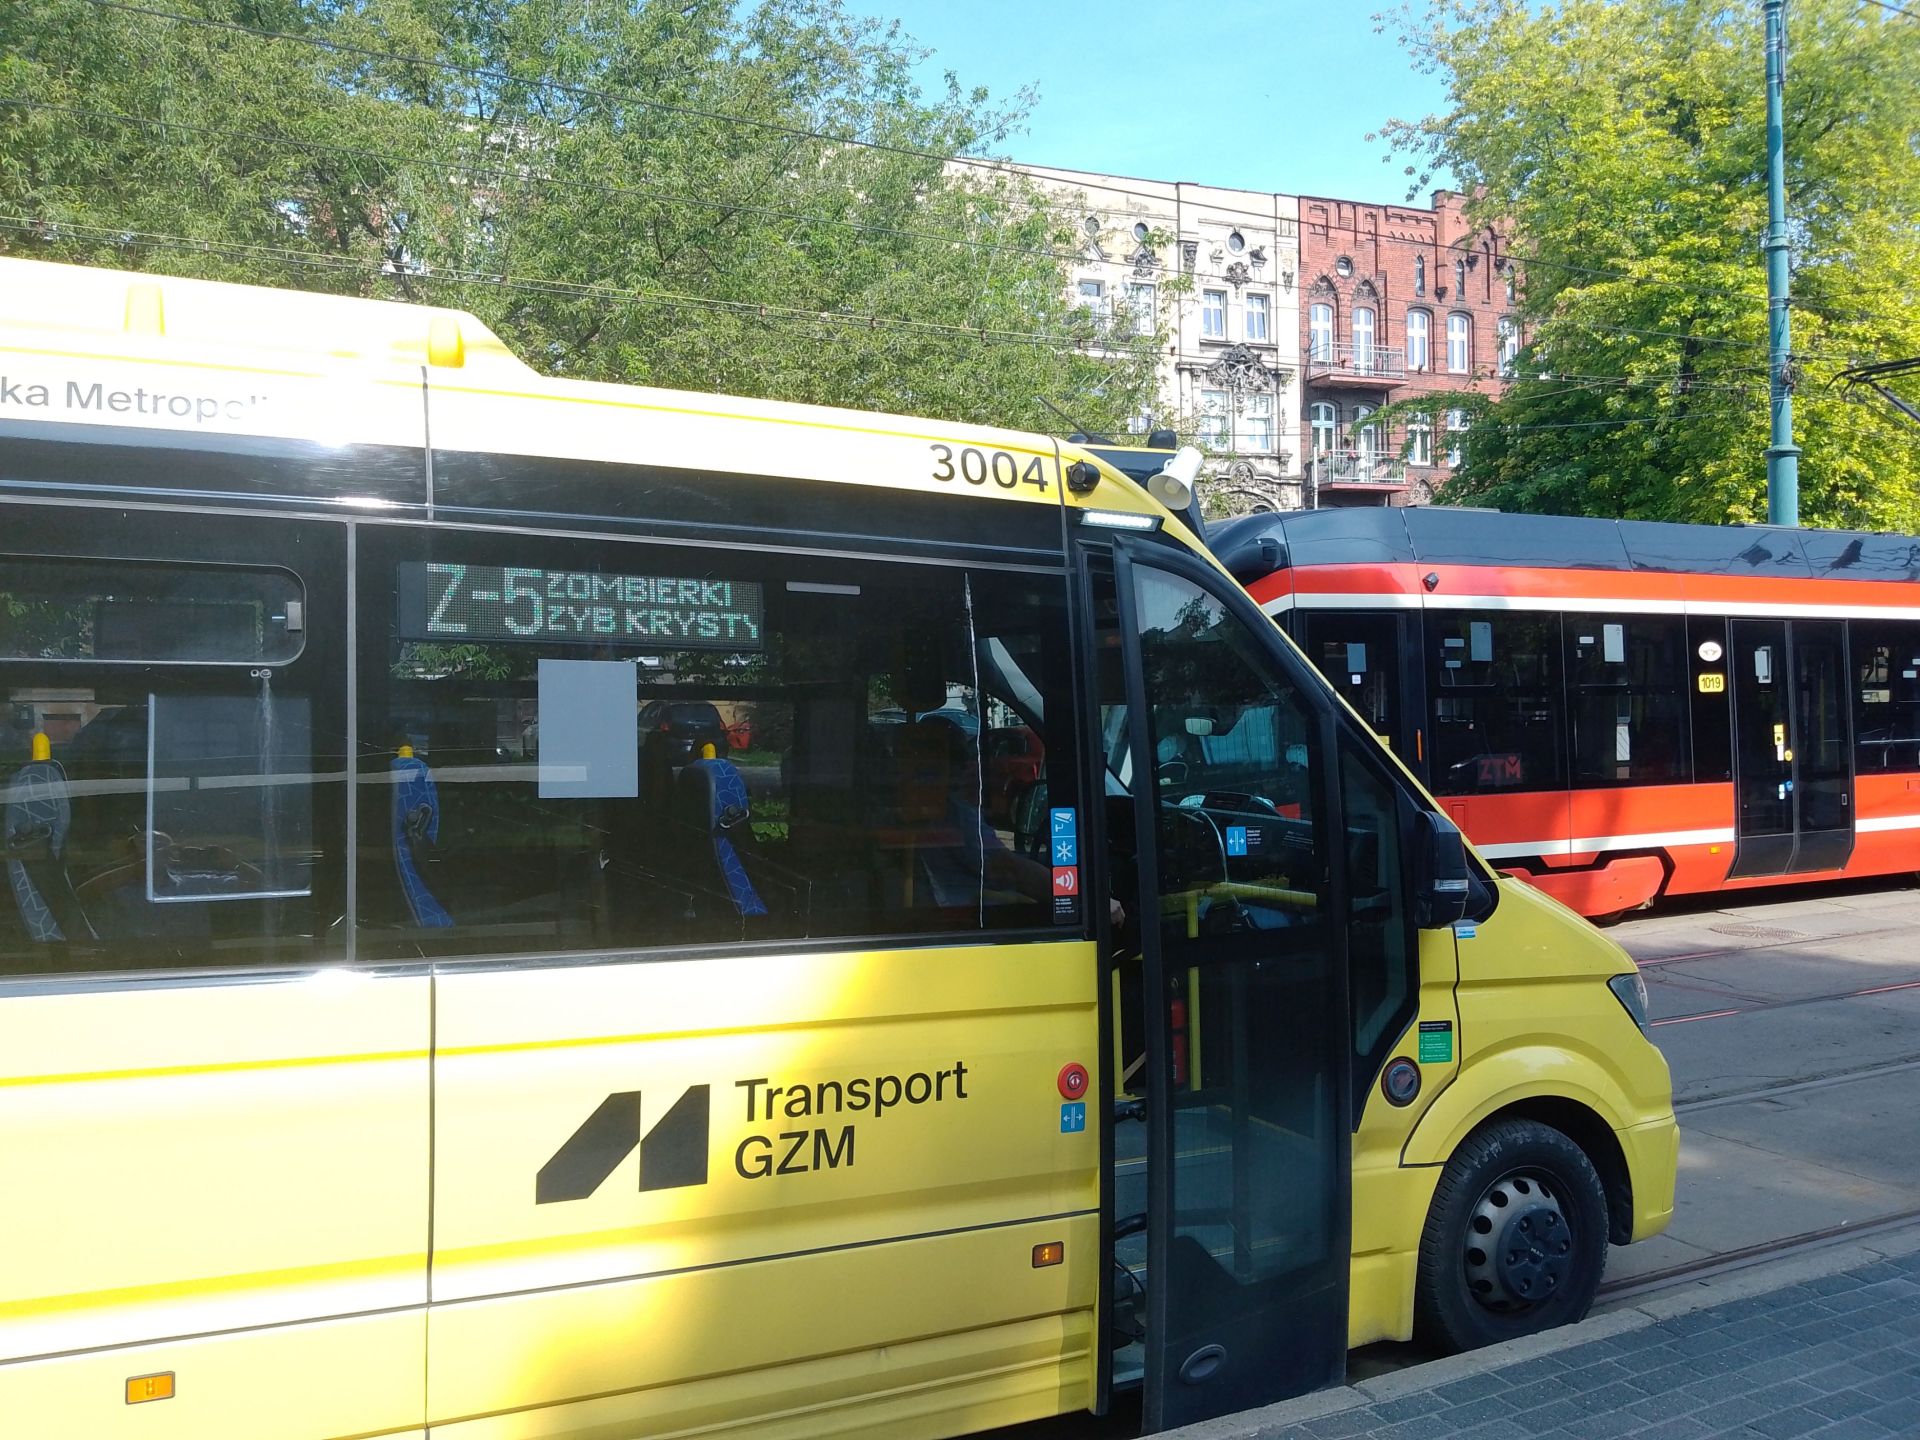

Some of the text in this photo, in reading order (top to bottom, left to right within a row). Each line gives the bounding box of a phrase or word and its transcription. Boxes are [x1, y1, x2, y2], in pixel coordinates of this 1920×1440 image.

[929, 444, 1048, 492] 3004
[426, 563, 543, 635] Z-5
[547, 573, 731, 606] ZOMBIERKI
[548, 606, 616, 633] ZYB
[1701, 676, 1721, 689] 1019
[1480, 755, 1521, 780] ZTM
[735, 1061, 968, 1122] Transport
[735, 1125, 855, 1179] GZM
